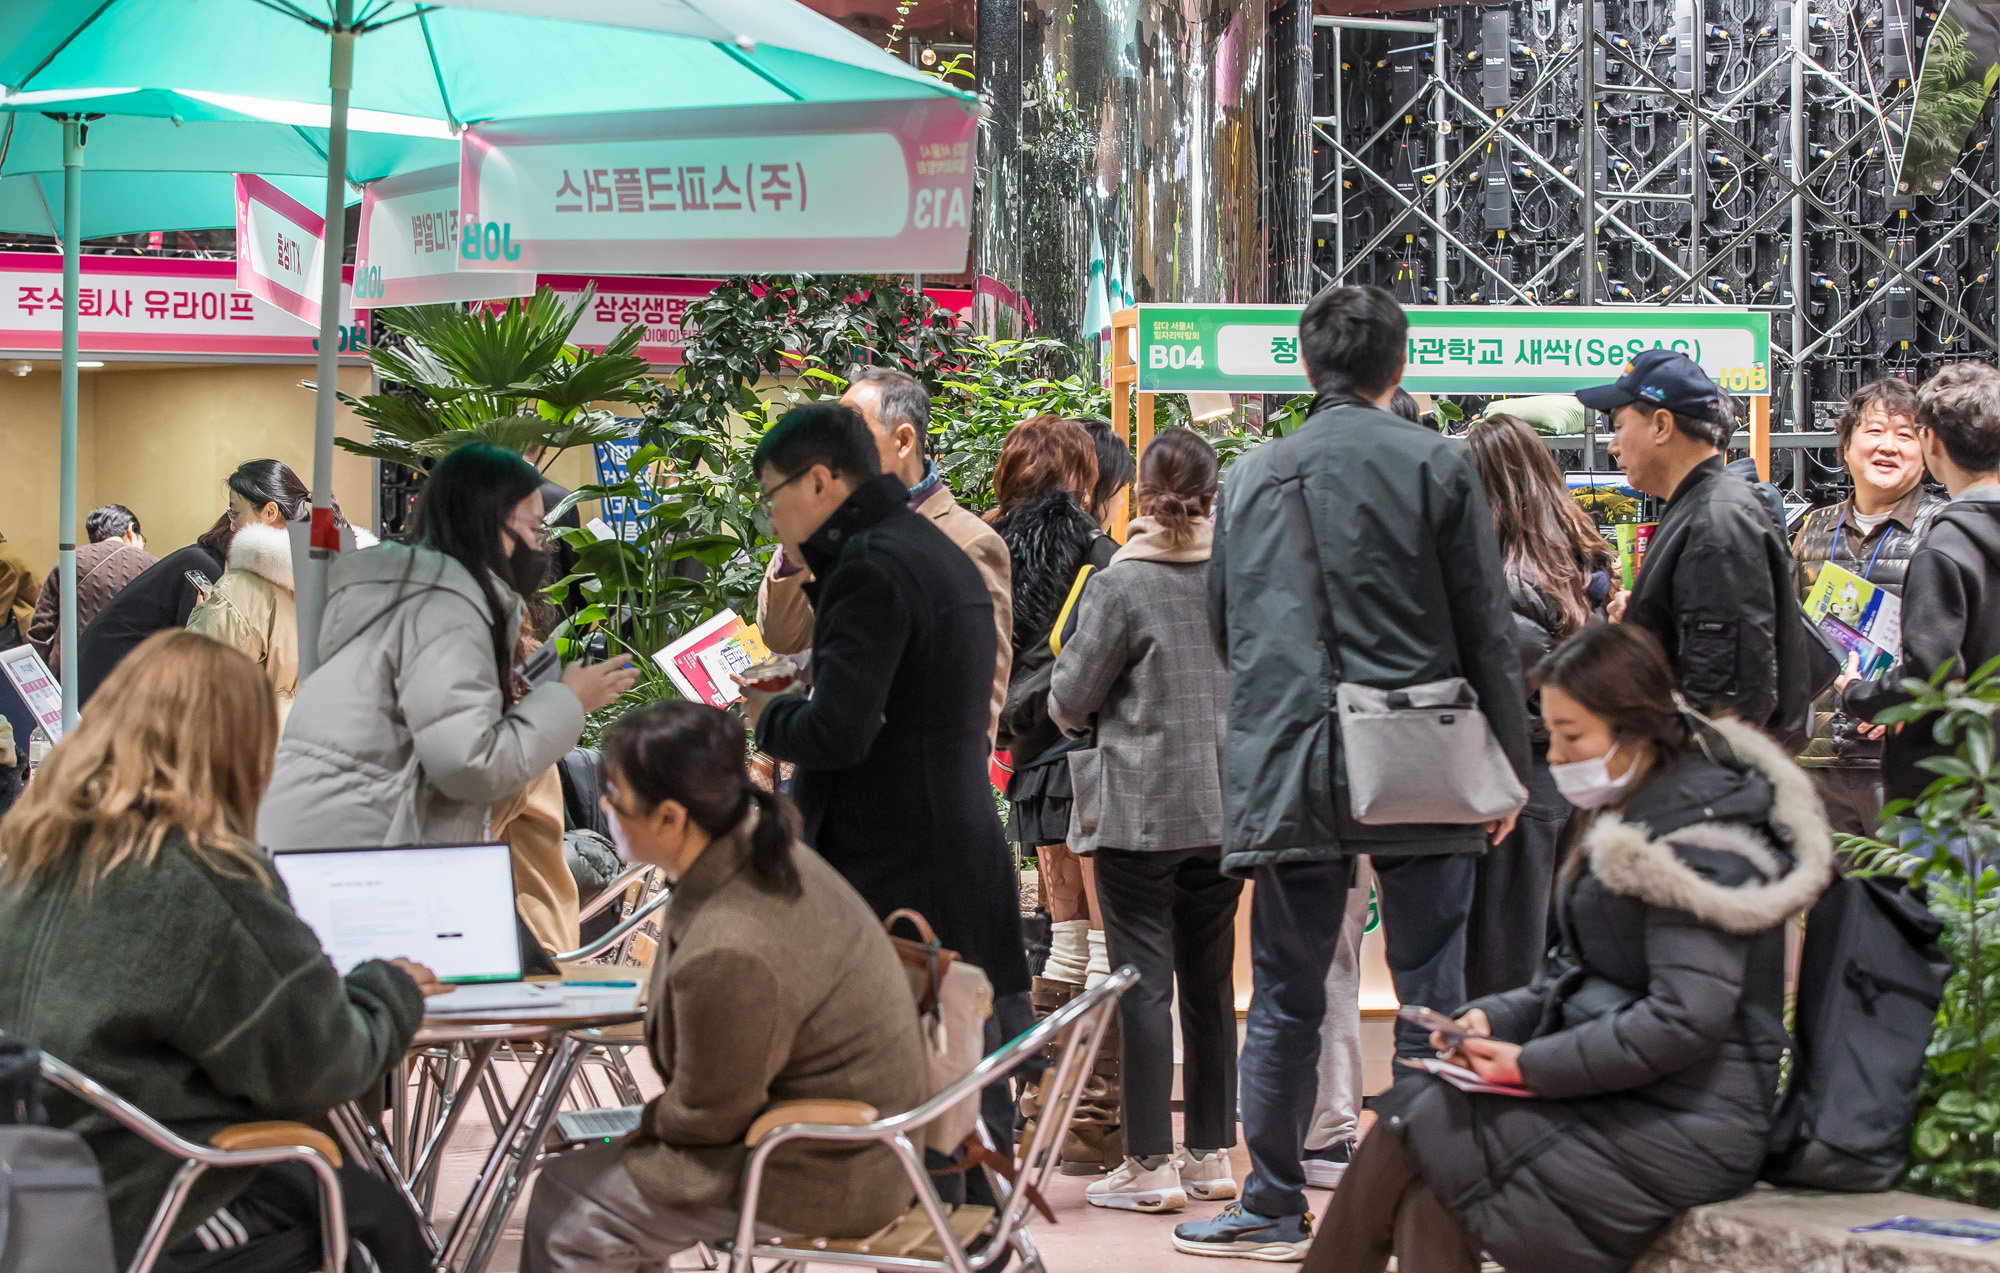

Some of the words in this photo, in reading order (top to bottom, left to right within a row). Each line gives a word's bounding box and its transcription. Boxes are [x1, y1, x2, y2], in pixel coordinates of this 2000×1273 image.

[145, 290, 255, 321] 유라이프
[1153, 321, 1169, 331] 잡다
[1171, 321, 1194, 331] 서울시
[1153, 331, 1200, 340] 일자리박람회
[1149, 345, 1205, 369] B04
[1712, 366, 1768, 391] JOB
